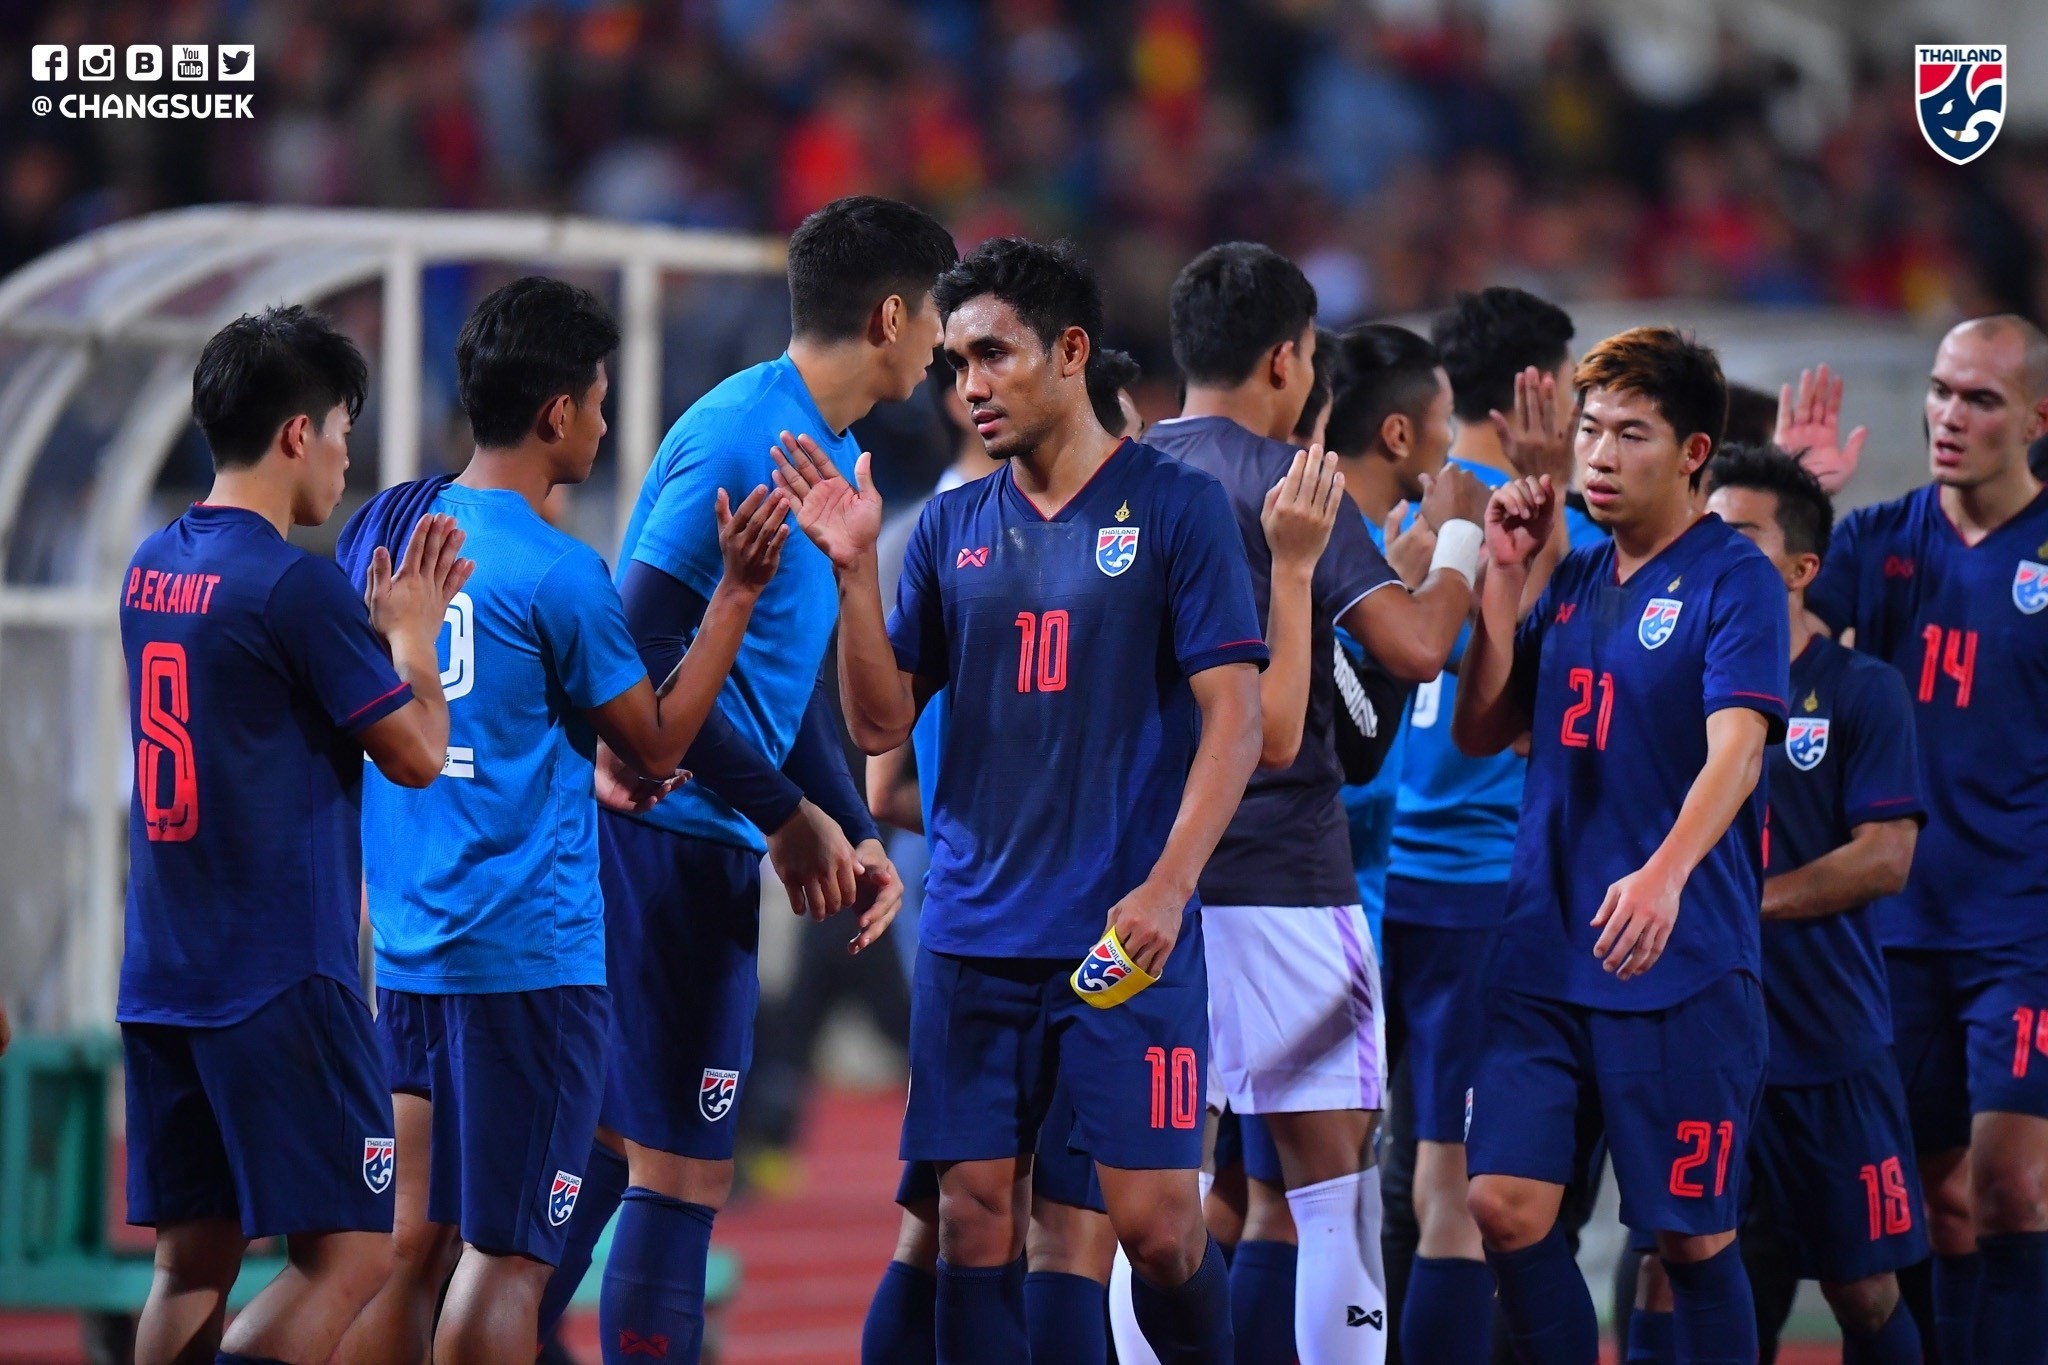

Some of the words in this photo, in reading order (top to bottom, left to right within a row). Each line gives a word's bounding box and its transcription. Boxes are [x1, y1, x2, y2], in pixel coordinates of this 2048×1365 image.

[125, 566, 221, 615] P.EKANIT
[1014, 609, 1069, 693] 10
[1918, 624, 1977, 708] 14
[138, 641, 198, 842] 8
[1560, 667, 1615, 750] 21
[1107, 939, 1131, 973] THAILAND
[705, 1070, 736, 1079] THAILAND
[1144, 1046, 1197, 1129] 10
[1669, 1120, 1733, 1198] 21
[1859, 1155, 1912, 1241] 18
